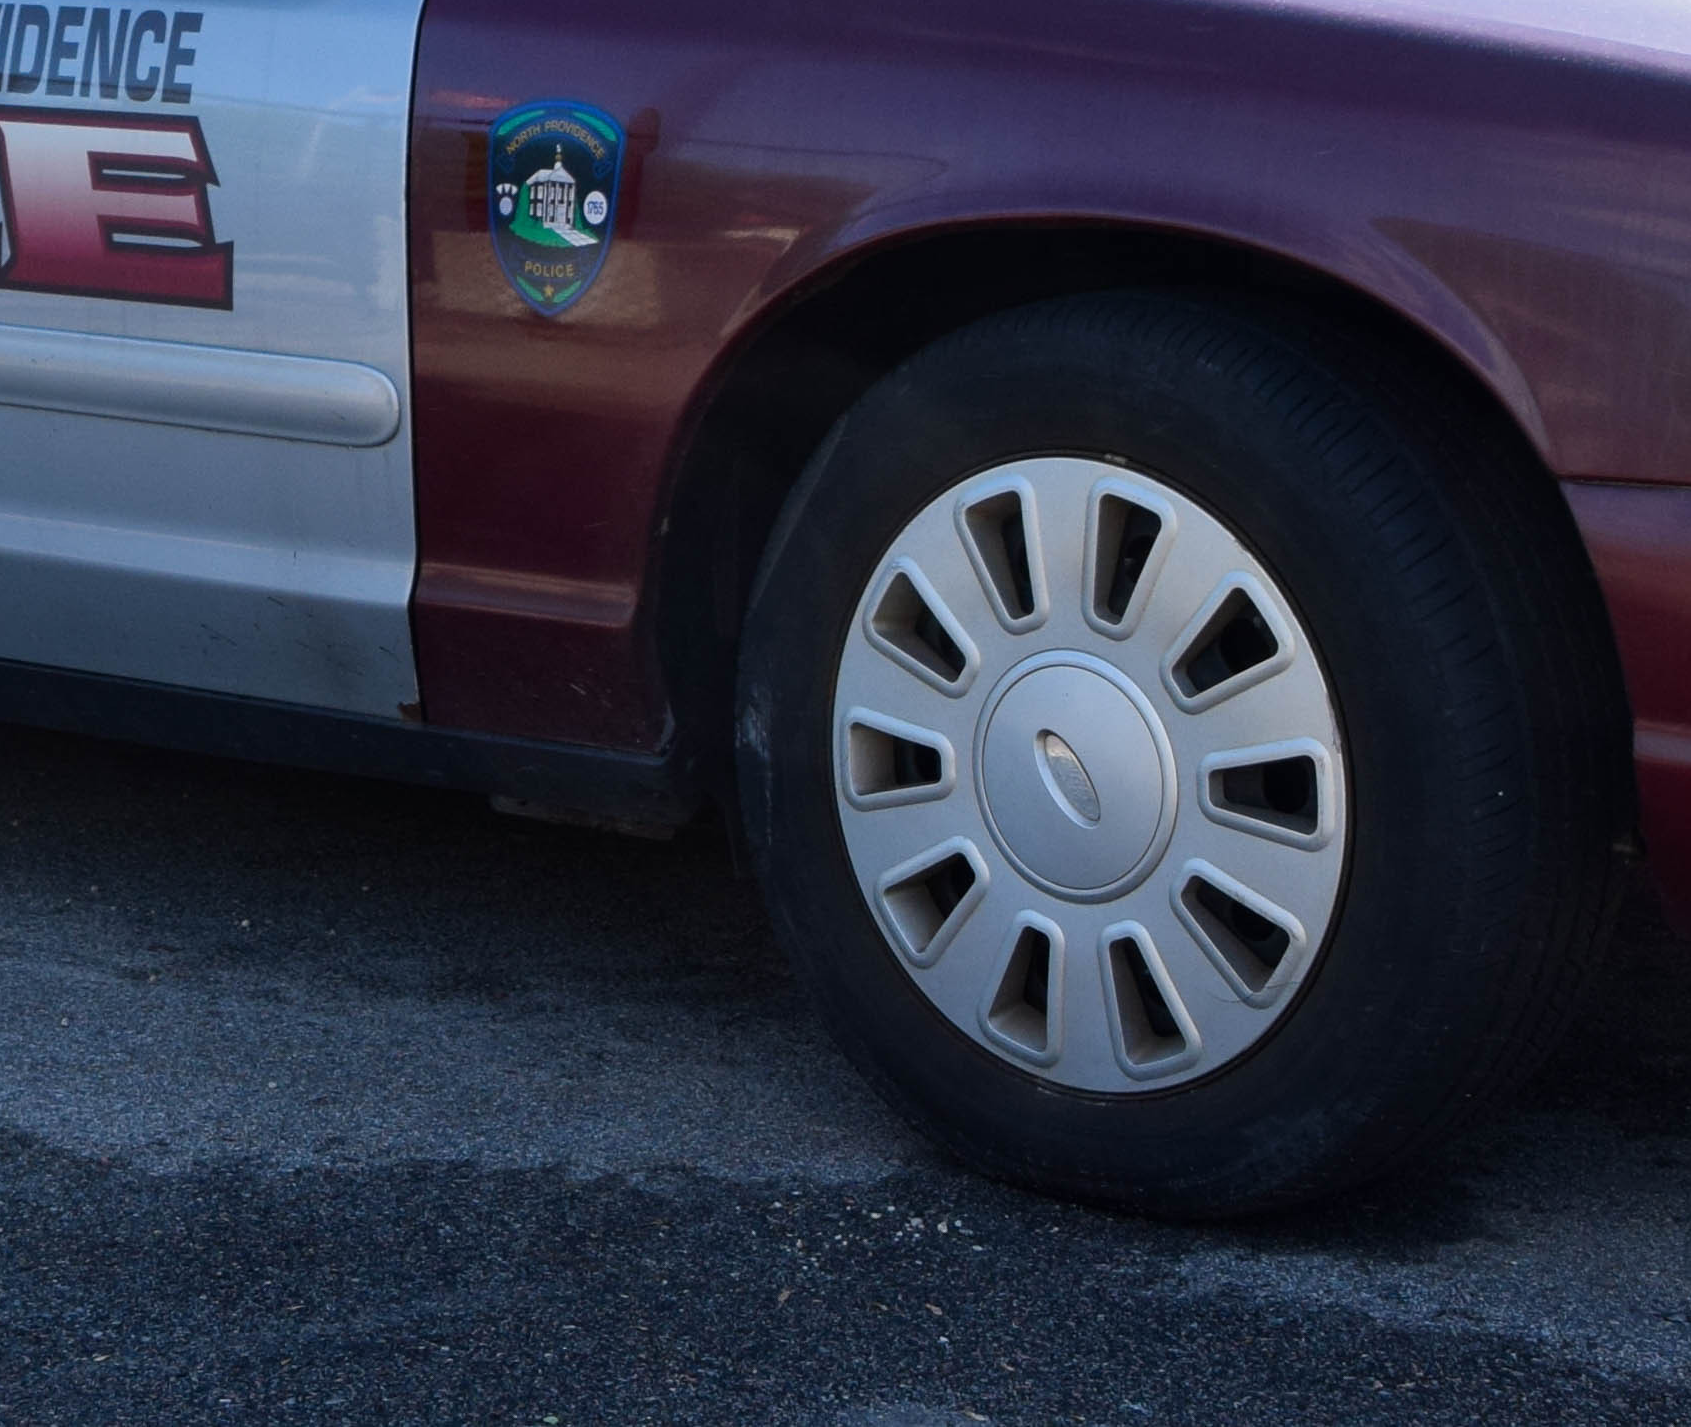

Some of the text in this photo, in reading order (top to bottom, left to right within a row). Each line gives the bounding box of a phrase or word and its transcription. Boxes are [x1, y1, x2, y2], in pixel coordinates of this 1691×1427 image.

[505, 119, 605, 159] NORTH PROVIDENCE
[587, 200, 604, 216] 1765
[524, 260, 574, 278] POLICE
